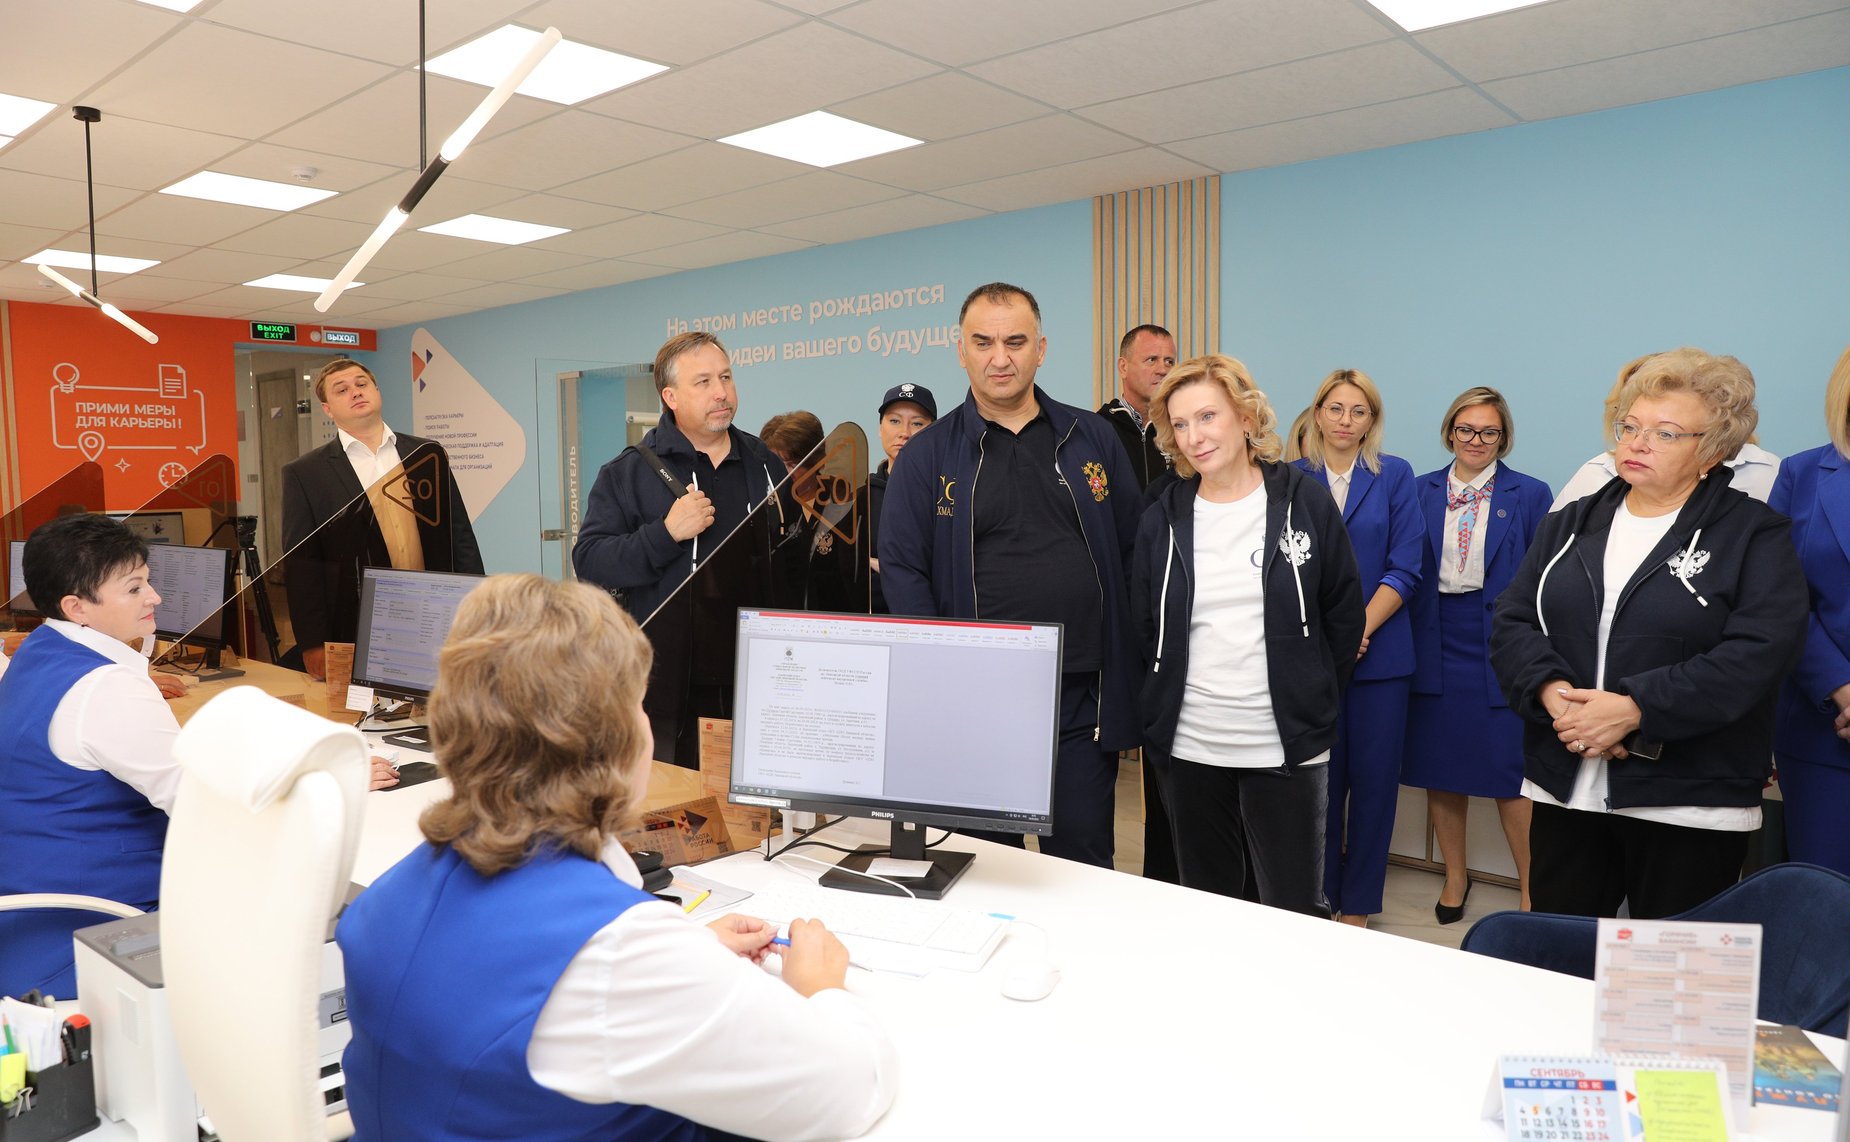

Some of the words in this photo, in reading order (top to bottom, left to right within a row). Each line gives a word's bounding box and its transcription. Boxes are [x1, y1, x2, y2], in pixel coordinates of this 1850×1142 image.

[666, 317, 688, 337] На
[692, 310, 737, 334] этом
[742, 304, 802, 327] месте
[809, 283, 945, 324] рождаются
[256, 323, 290, 334] ВЫХОД
[263, 332, 284, 340] EXIT
[326, 332, 356, 344] ВЫХОД
[729, 344, 776, 367] идеи
[782, 333, 862, 361] вашего
[866, 323, 962, 357] будуще
[898, 390, 915, 399] СФ
[75, 401, 130, 414] ПРИМИ
[134, 403, 176, 416] МЕРЫ
[75, 415, 106, 429] ДЛЯ
[659, 468, 673, 482] SONY
[569, 446, 579, 577] ОВОДИТЕЛЬ
[871, 811, 895, 819] PHILIPS
[1530, 1068, 1585, 1078] СЕНТЯБРЬ
[1583, 1096, 1589, 1104] 2
[1596, 1096, 1603, 1104] 3
[1520, 1106, 1526, 1114] 4
[1545, 1107, 1551, 1115] 6
[1558, 1107, 1564, 1115] 7
[1571, 1107, 1577, 1116] 8
[1583, 1108, 1590, 1116] 9
[1595, 1108, 1605, 1116] 10
[1521, 1118, 1528, 1126] 11
[1533, 1118, 1541, 1127] 12
[1545, 1118, 1554, 1127] 13
[1557, 1119, 1567, 1127] 14
[1571, 1119, 1580, 1128] 15
[1584, 1119, 1593, 1128] 16
[1597, 1119, 1606, 1128] 17
[1521, 1130, 1530, 1138] 18
[1534, 1130, 1543, 1139] 19
[1545, 1130, 1556, 1139] 20
[1561, 1131, 1570, 1139] 21
[1572, 1131, 1582, 1140] 22
[1585, 1131, 1596, 1140] 23
[1597, 1131, 1609, 1140] 24
